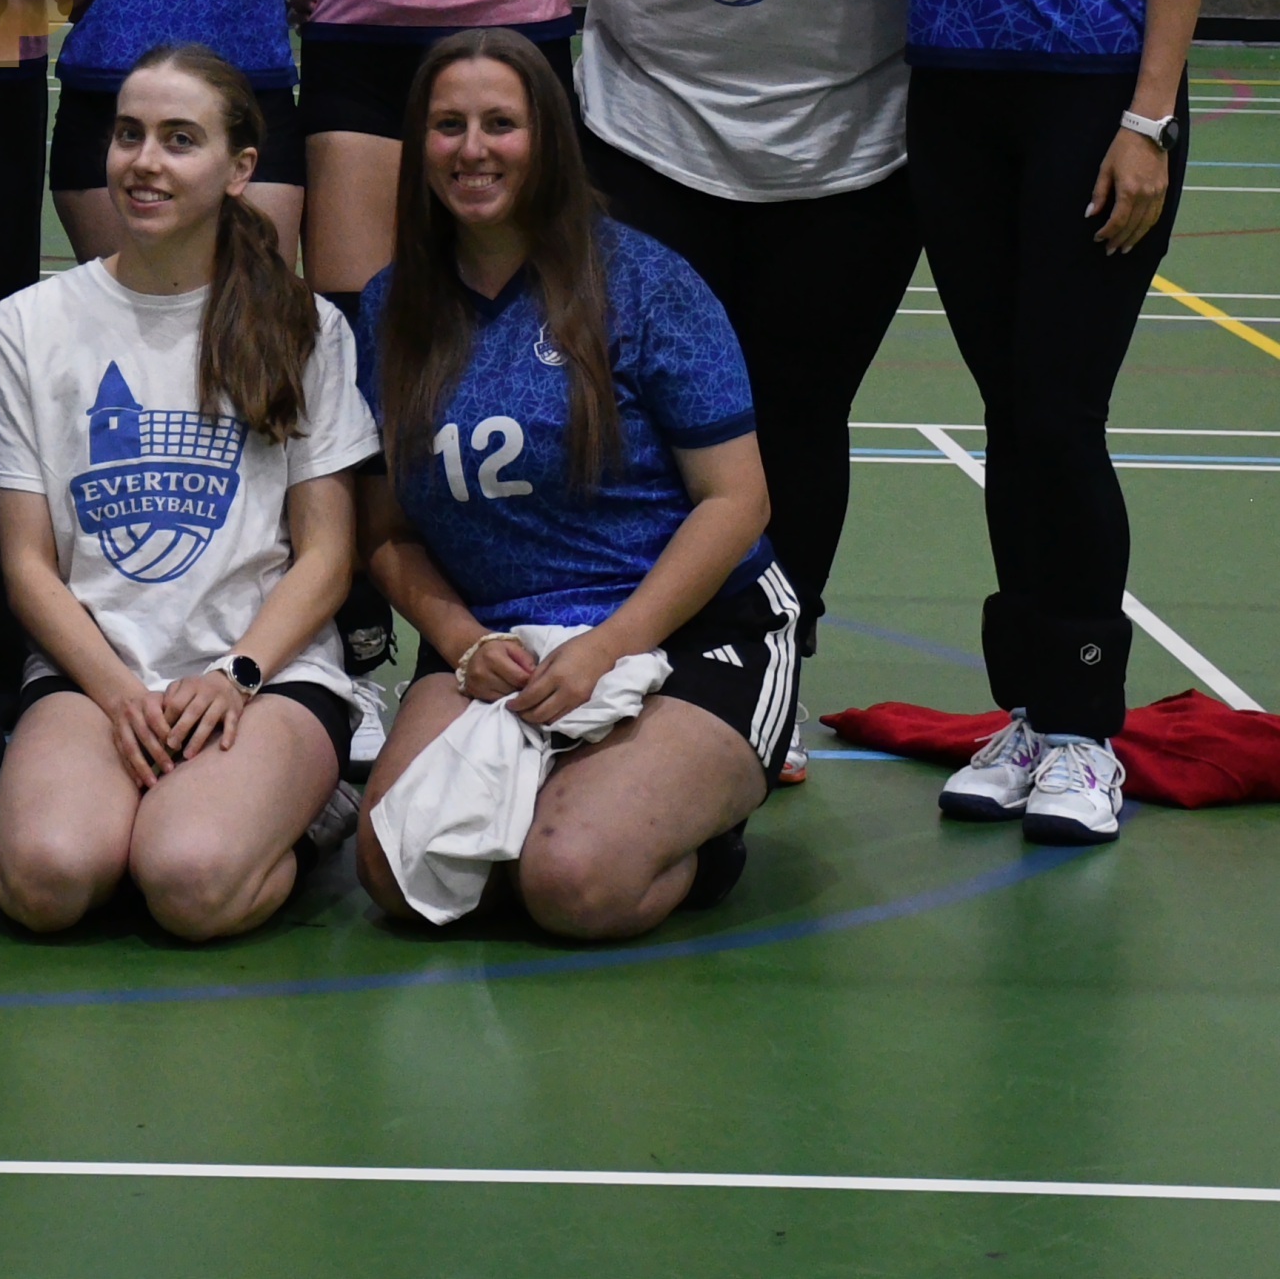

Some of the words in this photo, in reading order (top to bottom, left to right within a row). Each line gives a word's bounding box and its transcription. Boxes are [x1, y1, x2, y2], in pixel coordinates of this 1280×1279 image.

[430, 415, 533, 502] 12
[80, 472, 229, 502] EVERTON
[86, 496, 218, 522] VOLLEYBALL
